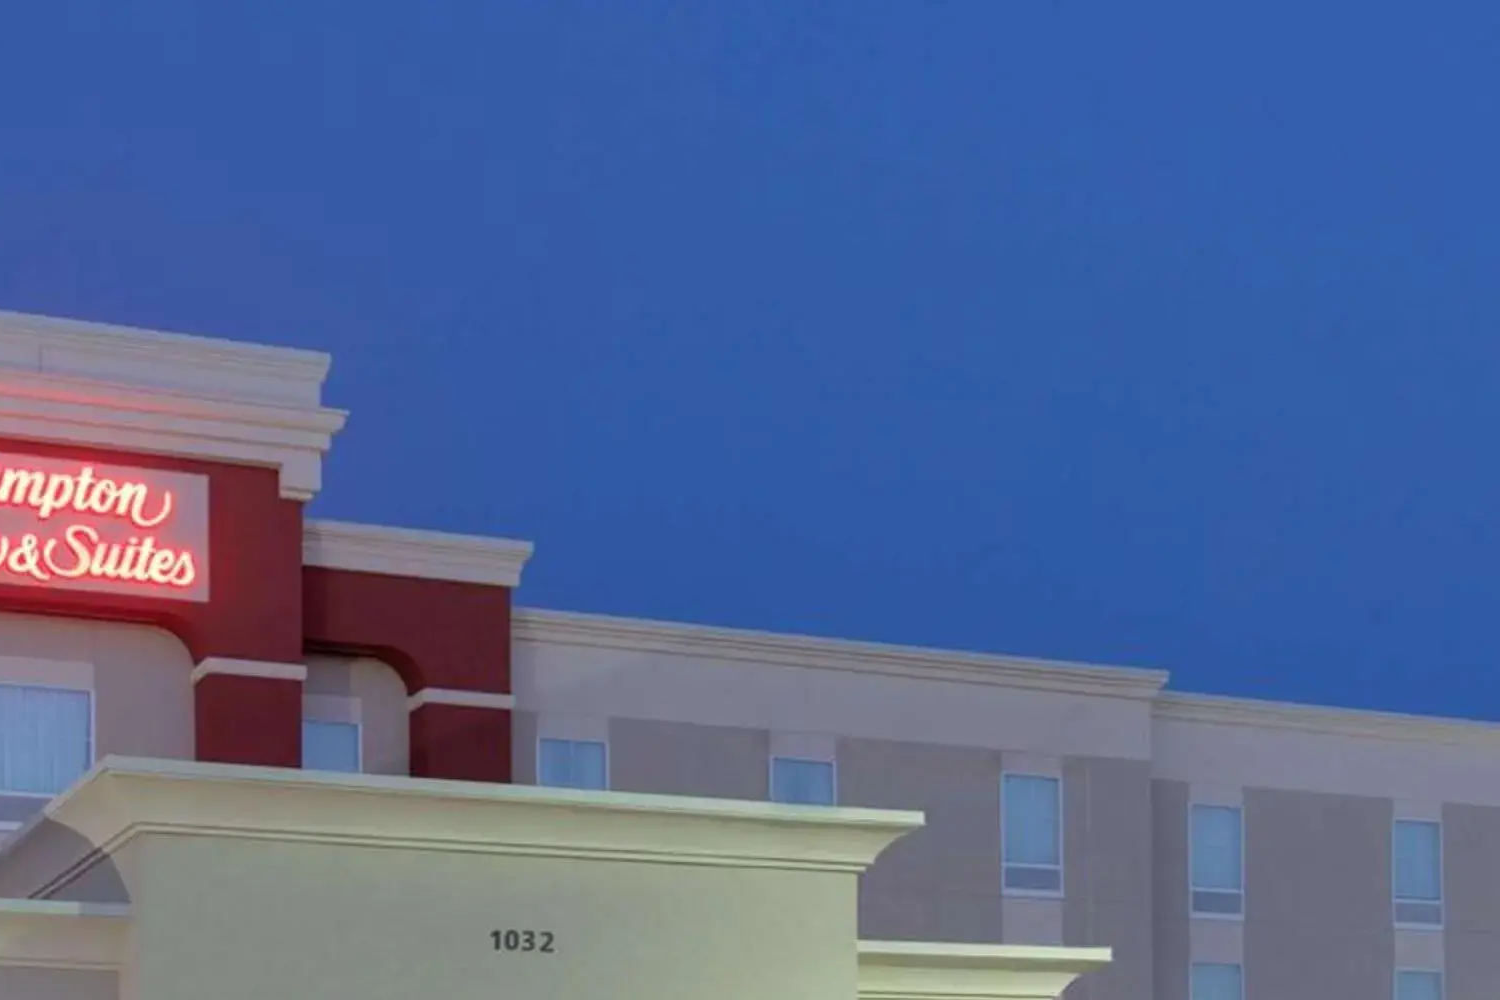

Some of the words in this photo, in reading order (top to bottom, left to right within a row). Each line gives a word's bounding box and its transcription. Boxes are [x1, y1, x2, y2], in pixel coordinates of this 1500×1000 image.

[8, 533, 50, 581] &
[43, 524, 196, 587] Suites
[489, 929, 555, 953] 1032
